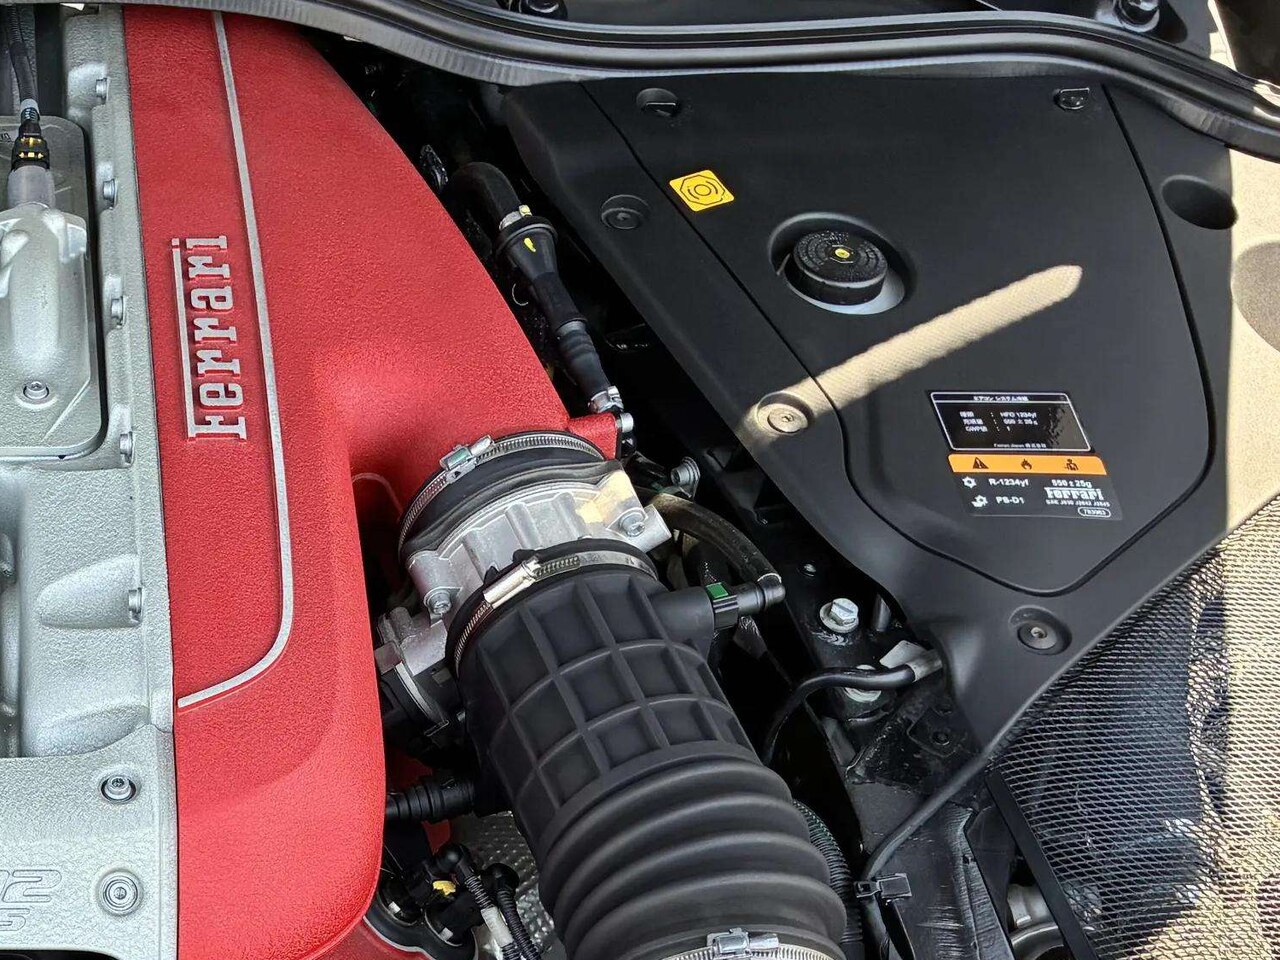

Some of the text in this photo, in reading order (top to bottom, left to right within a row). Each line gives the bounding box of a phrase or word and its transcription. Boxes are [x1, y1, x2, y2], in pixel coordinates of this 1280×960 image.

[170, 234, 247, 441] Ferrari
[988, 478, 1029, 487] R-1234yf
[1044, 487, 1104, 501] Ferrari
